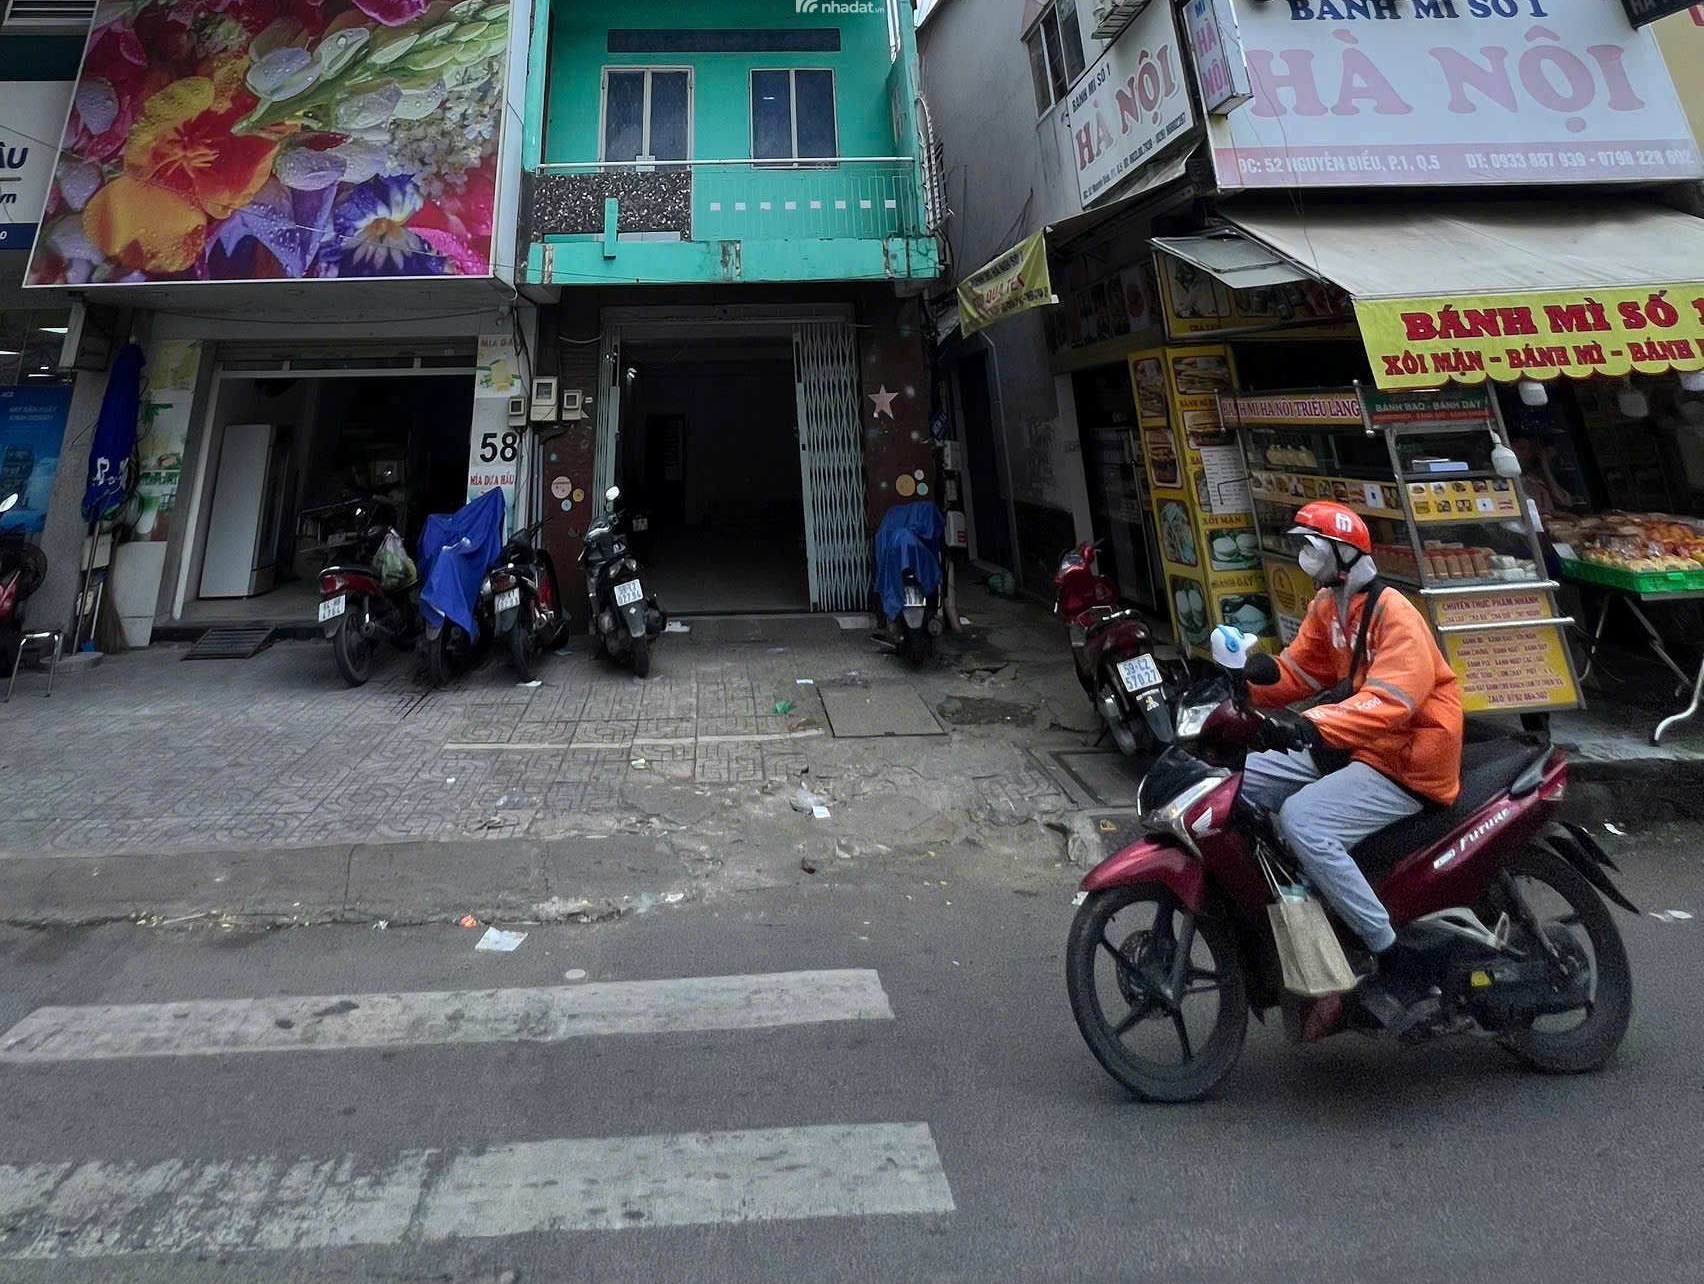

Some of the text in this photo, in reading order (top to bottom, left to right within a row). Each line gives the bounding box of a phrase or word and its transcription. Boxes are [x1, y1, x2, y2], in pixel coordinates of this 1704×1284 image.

[1246, 24, 1647, 134] HÀ NỘI
[1075, 99, 1115, 171] HÀ
[1115, 44, 1176, 135] NỘI
[1265, 157, 1283, 173] 52
[1400, 303, 1539, 341] BÁNH
[1542, 297, 1612, 334] MÌ
[1617, 289, 1679, 330] SỐ
[1381, 349, 1429, 376] XÔI
[1430, 348, 1485, 377] MẶN
[1505, 343, 1572, 369] BÁNH
[1572, 340, 1607, 366] MÌ
[1626, 337, 1695, 363] BÁNH
[479, 431, 518, 463] 58
